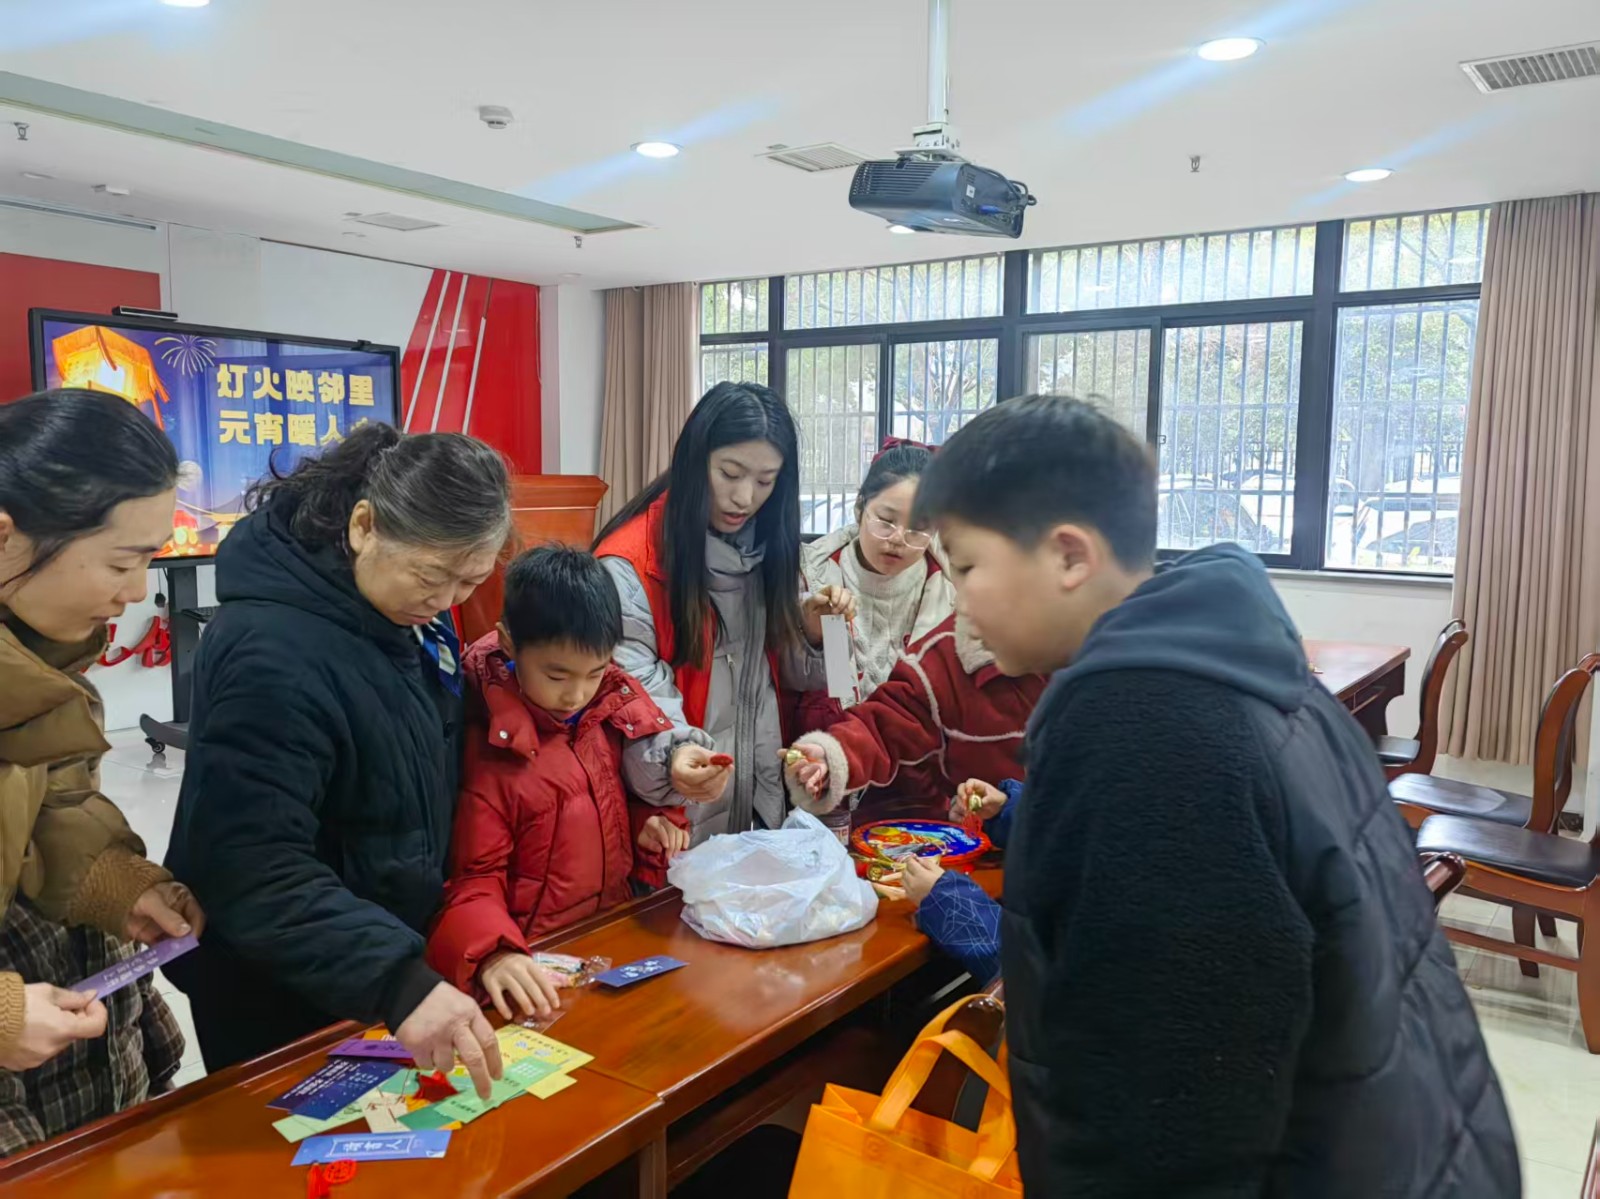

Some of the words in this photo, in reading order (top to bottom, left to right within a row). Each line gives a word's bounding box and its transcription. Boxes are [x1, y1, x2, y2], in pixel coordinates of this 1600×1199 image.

[217, 363, 375, 406] 灯火映邻里
[219, 409, 369, 446] 元宵暖人
